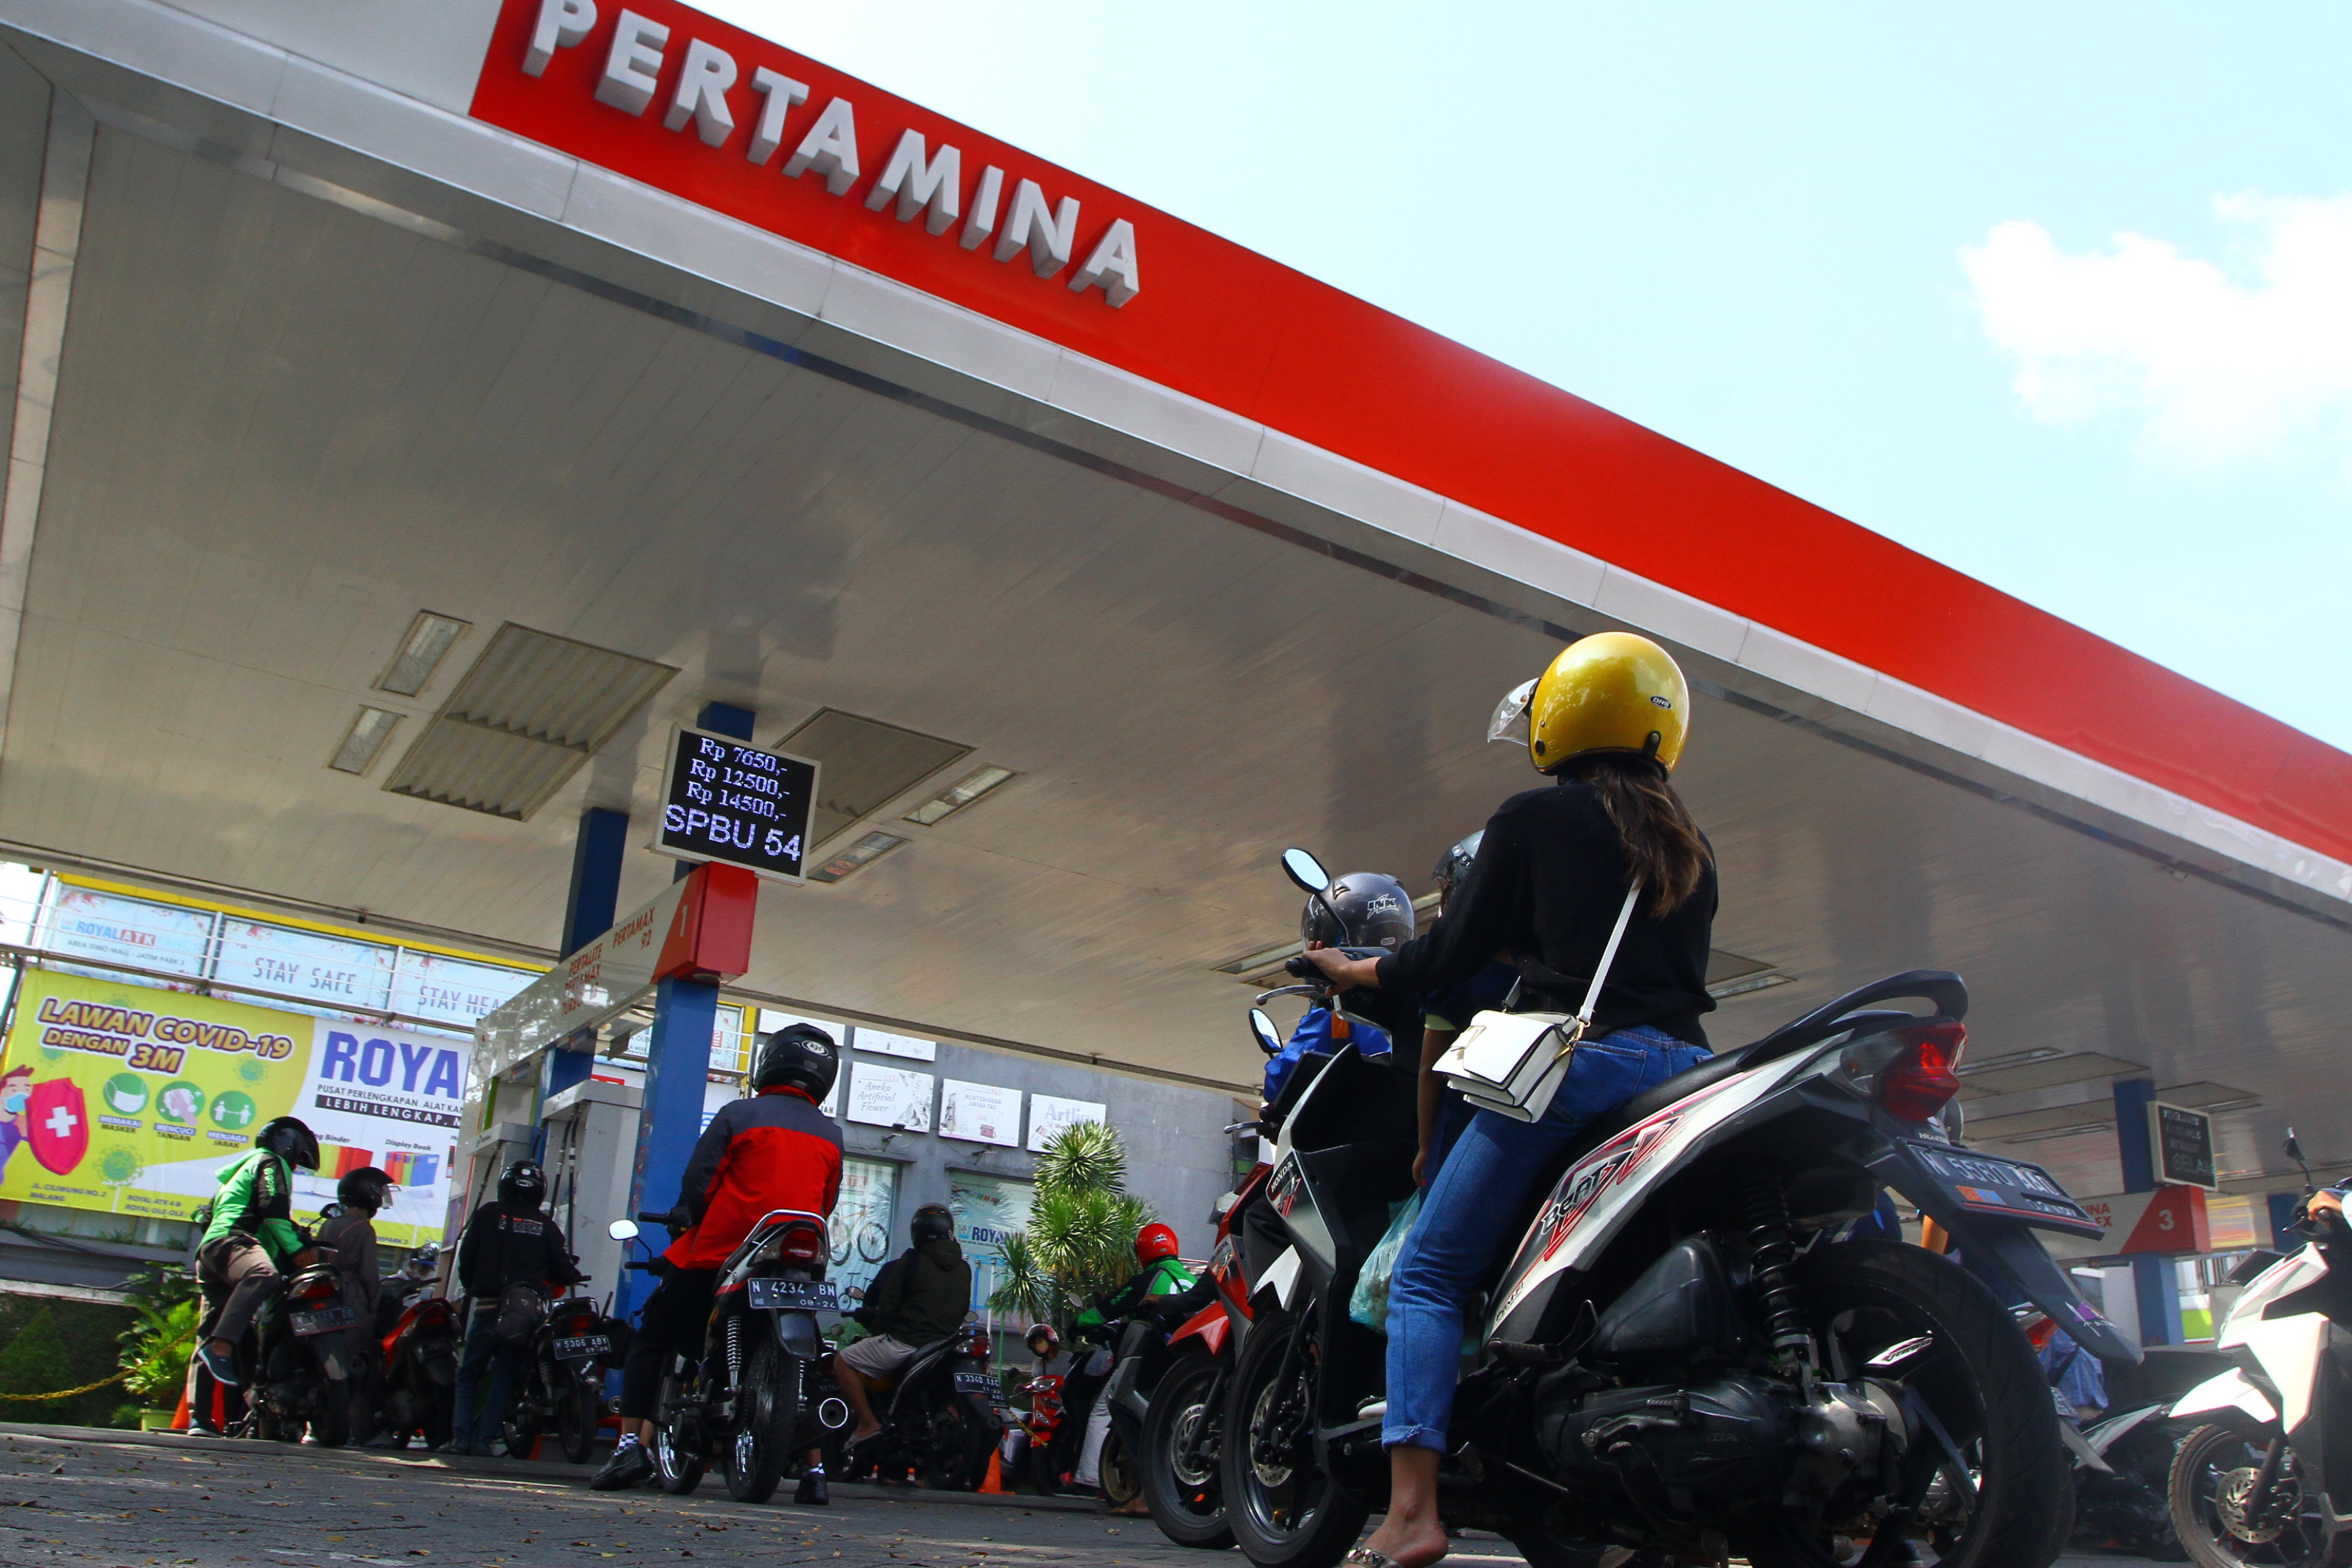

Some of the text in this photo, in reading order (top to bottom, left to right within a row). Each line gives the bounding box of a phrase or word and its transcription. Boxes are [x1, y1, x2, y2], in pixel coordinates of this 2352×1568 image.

[521, 0, 1140, 308] PERTAMINA
[1652, 696, 1670, 708] DNS
[700, 737, 725, 762] Rp
[690, 758, 716, 783] Rp
[686, 781, 713, 805] Rp
[664, 804, 800, 861] SPBU 54
[1367, 894, 1398, 916] INK
[612, 906, 655, 949] PERTAMAX
[680, 904, 688, 937] 1
[76, 921, 119, 940] ROYAL
[122, 930, 154, 946] ATK
[642, 929, 652, 949] 92
[67, 940, 86, 948] AREA
[88, 943, 108, 952] DINO
[569, 943, 603, 977] PERTALITE
[253, 957, 357, 994] STAY SAFE
[418, 985, 508, 1016] STAY HEA
[39, 998, 292, 1060] LAWAN COVID-19
[44, 1028, 184, 1074] DENGAN 3M
[321, 1030, 471, 1100] ROYA
[865, 1081, 891, 1092] Aneka
[318, 1084, 345, 1095] PUSAT
[348, 1089, 419, 1107] PERLENGKAPAN
[423, 1101, 444, 1111] ALAT
[858, 1091, 896, 1102] Artificial
[964, 1094, 1002, 1105] MENYEDIAKAN
[326, 1098, 368, 1113] LEBIH
[861, 1102, 889, 1112] Flower
[100, 1115, 141, 1127] MEMAKAI
[101, 1124, 136, 1133] MASKER
[155, 1124, 195, 1135] MENCUCI
[157, 1132, 191, 1141] TANGAN
[208, 1132, 248, 1143] MENJAGA
[212, 1140, 239, 1149] JARAK
[325, 1134, 351, 1144] Binder
[385, 1139, 432, 1151] Display Book
[1919, 1132, 1949, 1145] HONDA
[1271, 1161, 1293, 1193] HONDA
[2158, 1209, 2174, 1231] 3
[751, 1281, 836, 1296] N 4234 BN
[800, 1298, 836, 1309] 08-24
[564, 1339, 587, 1348] 5306
[591, 1337, 607, 1346] ABY
[965, 1375, 983, 1384] 3340
